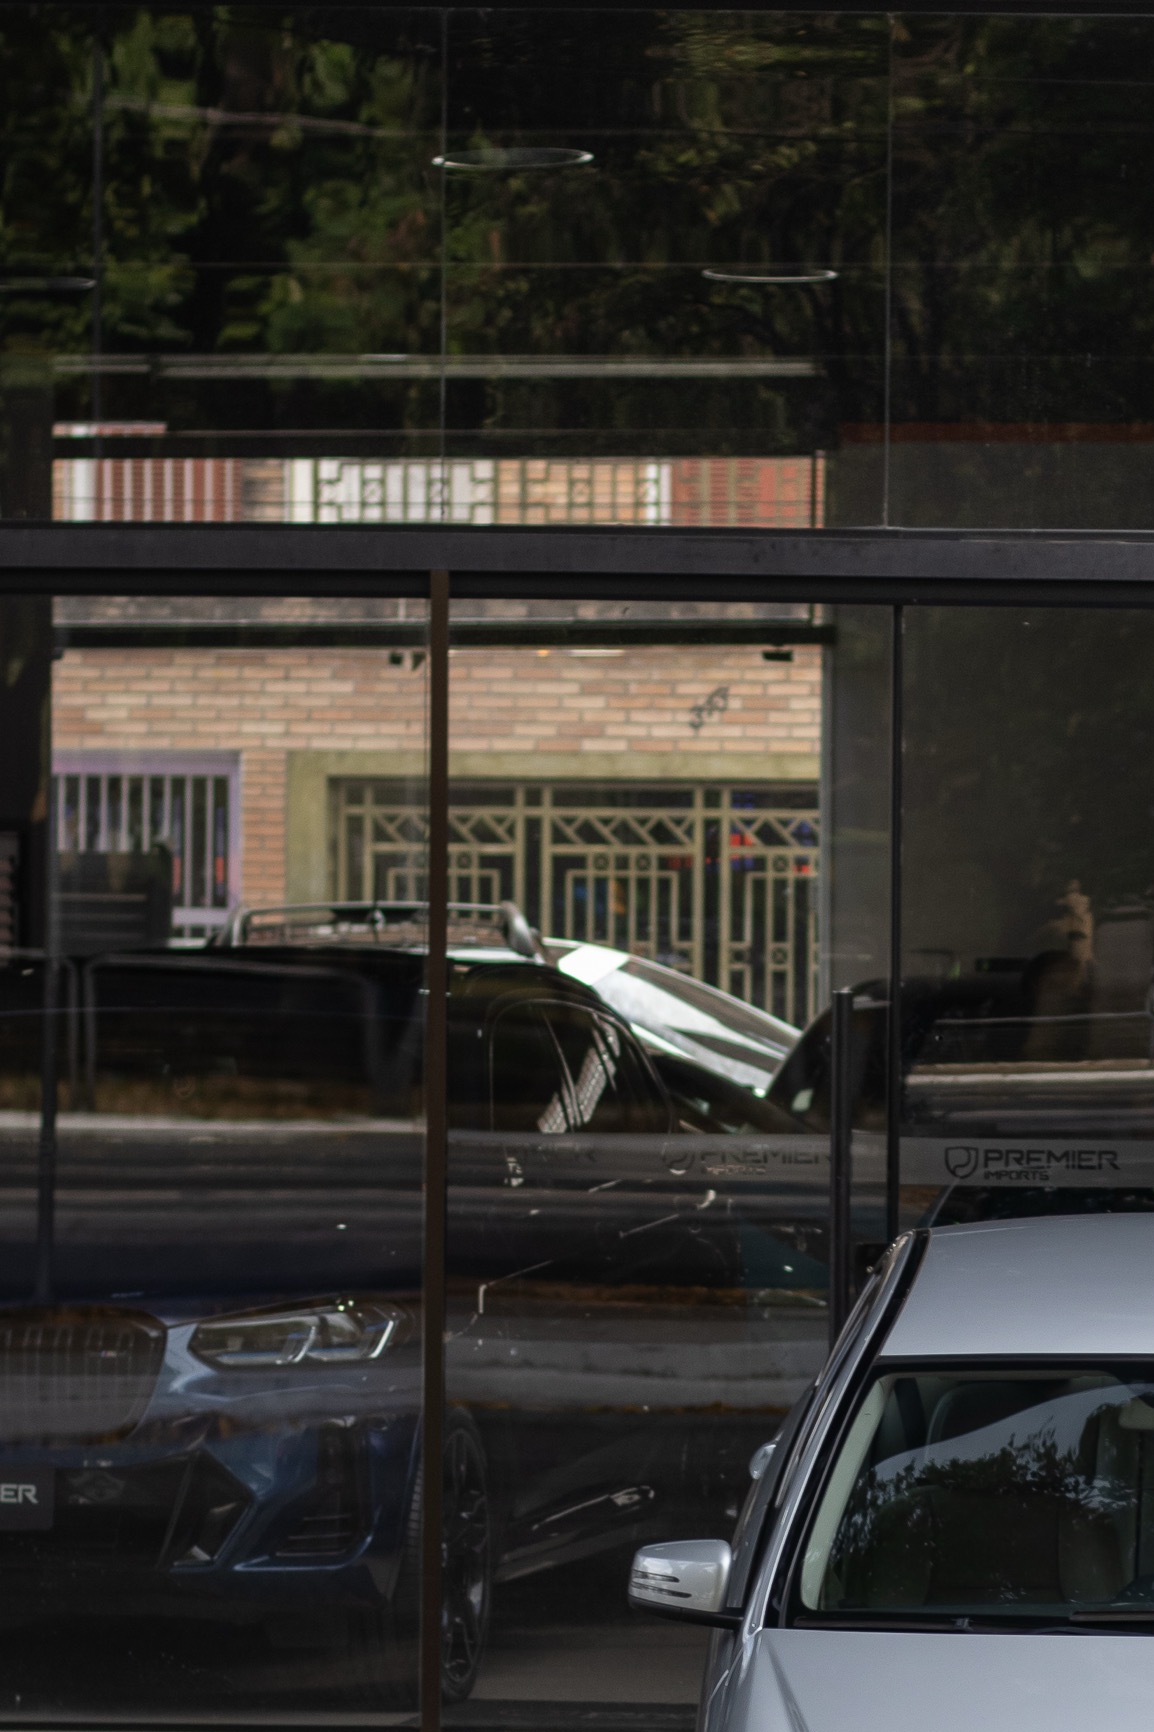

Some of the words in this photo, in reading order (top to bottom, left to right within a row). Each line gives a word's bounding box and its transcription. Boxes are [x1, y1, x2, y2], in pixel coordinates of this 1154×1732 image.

[983, 1148, 1121, 1171] PREMIER
[983, 1169, 1050, 1181] IMPORTS
[0, 1482, 39, 1505] ER
